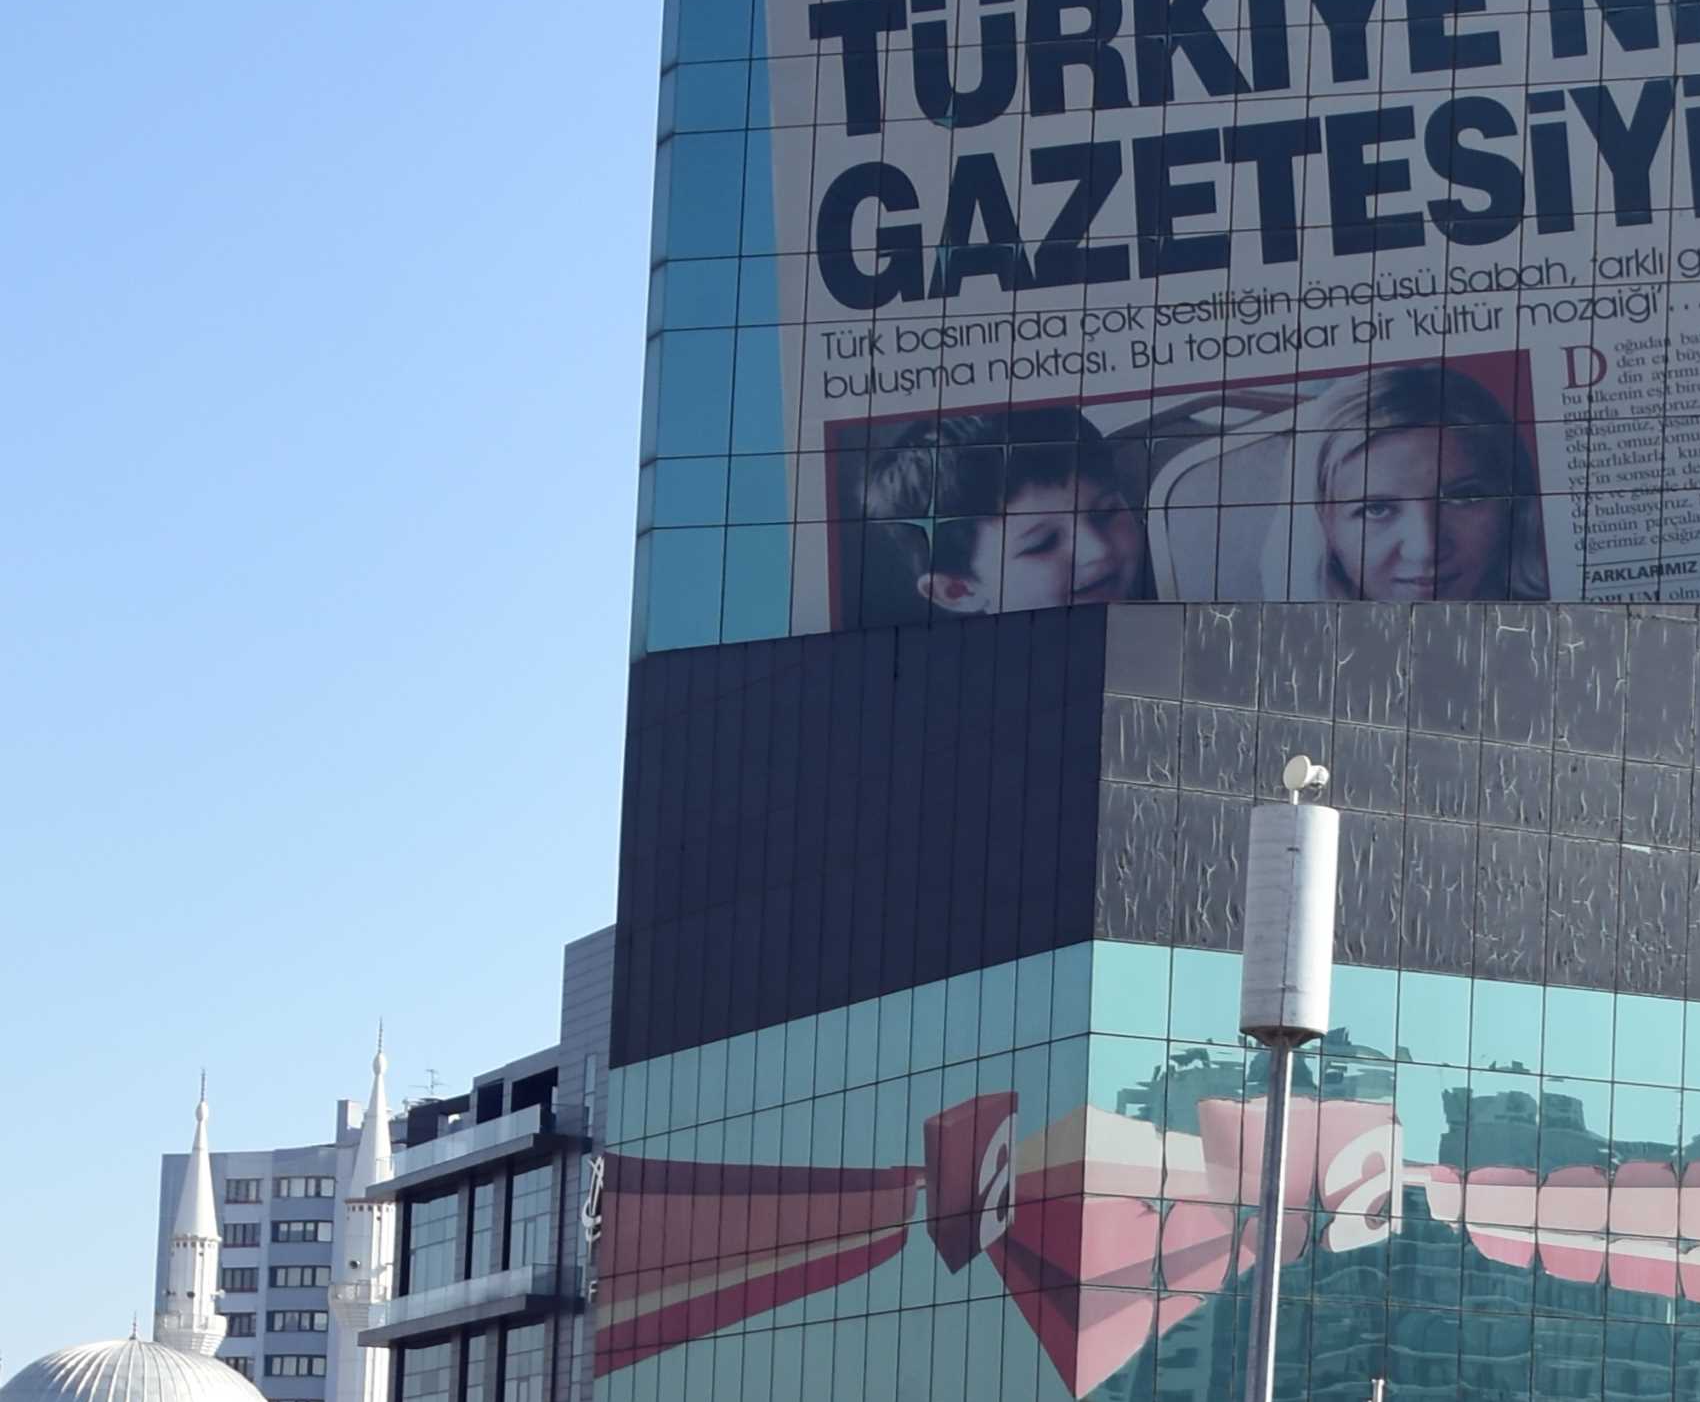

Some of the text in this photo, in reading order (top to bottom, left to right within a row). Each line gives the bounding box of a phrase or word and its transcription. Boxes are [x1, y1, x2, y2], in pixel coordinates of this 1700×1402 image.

[821, 327, 885, 361] Türk
[896, 311, 1068, 354] basınında
[1080, 303, 1145, 341] çok
[1303, 267, 1438, 311] öncüsü
[1450, 257, 1578, 297] Sabah,
[823, 360, 976, 399] buluşma
[988, 349, 1117, 384] noktası.
[1131, 340, 1175, 371] Bu
[1184, 319, 1337, 367] topraklar
[1351, 312, 1395, 344] bir
[1584, 563, 1697, 582] FARKLARMIZ
